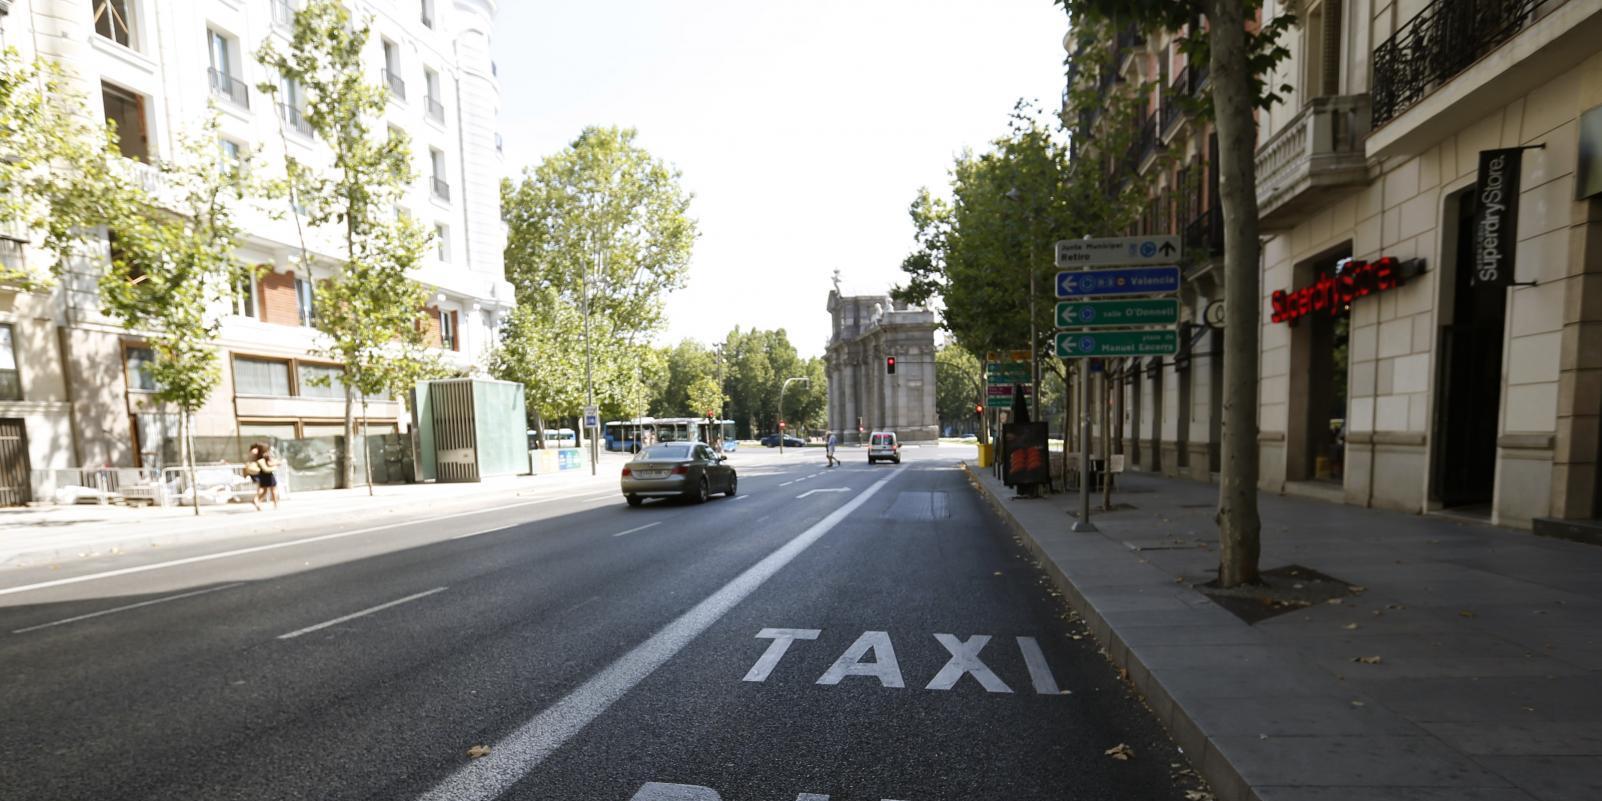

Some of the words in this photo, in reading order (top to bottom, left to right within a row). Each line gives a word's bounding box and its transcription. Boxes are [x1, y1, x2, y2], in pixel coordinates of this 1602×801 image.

[1061, 243, 1082, 251] Junta
[1086, 242, 1123, 250] Municipal
[1061, 253, 1090, 261] Retiro
[1131, 276, 1175, 286] Valencia
[1125, 307, 1174, 317] O'Donnell
[1102, 343, 1135, 352] Manuel
[742, 628, 1060, 695] TAXI
